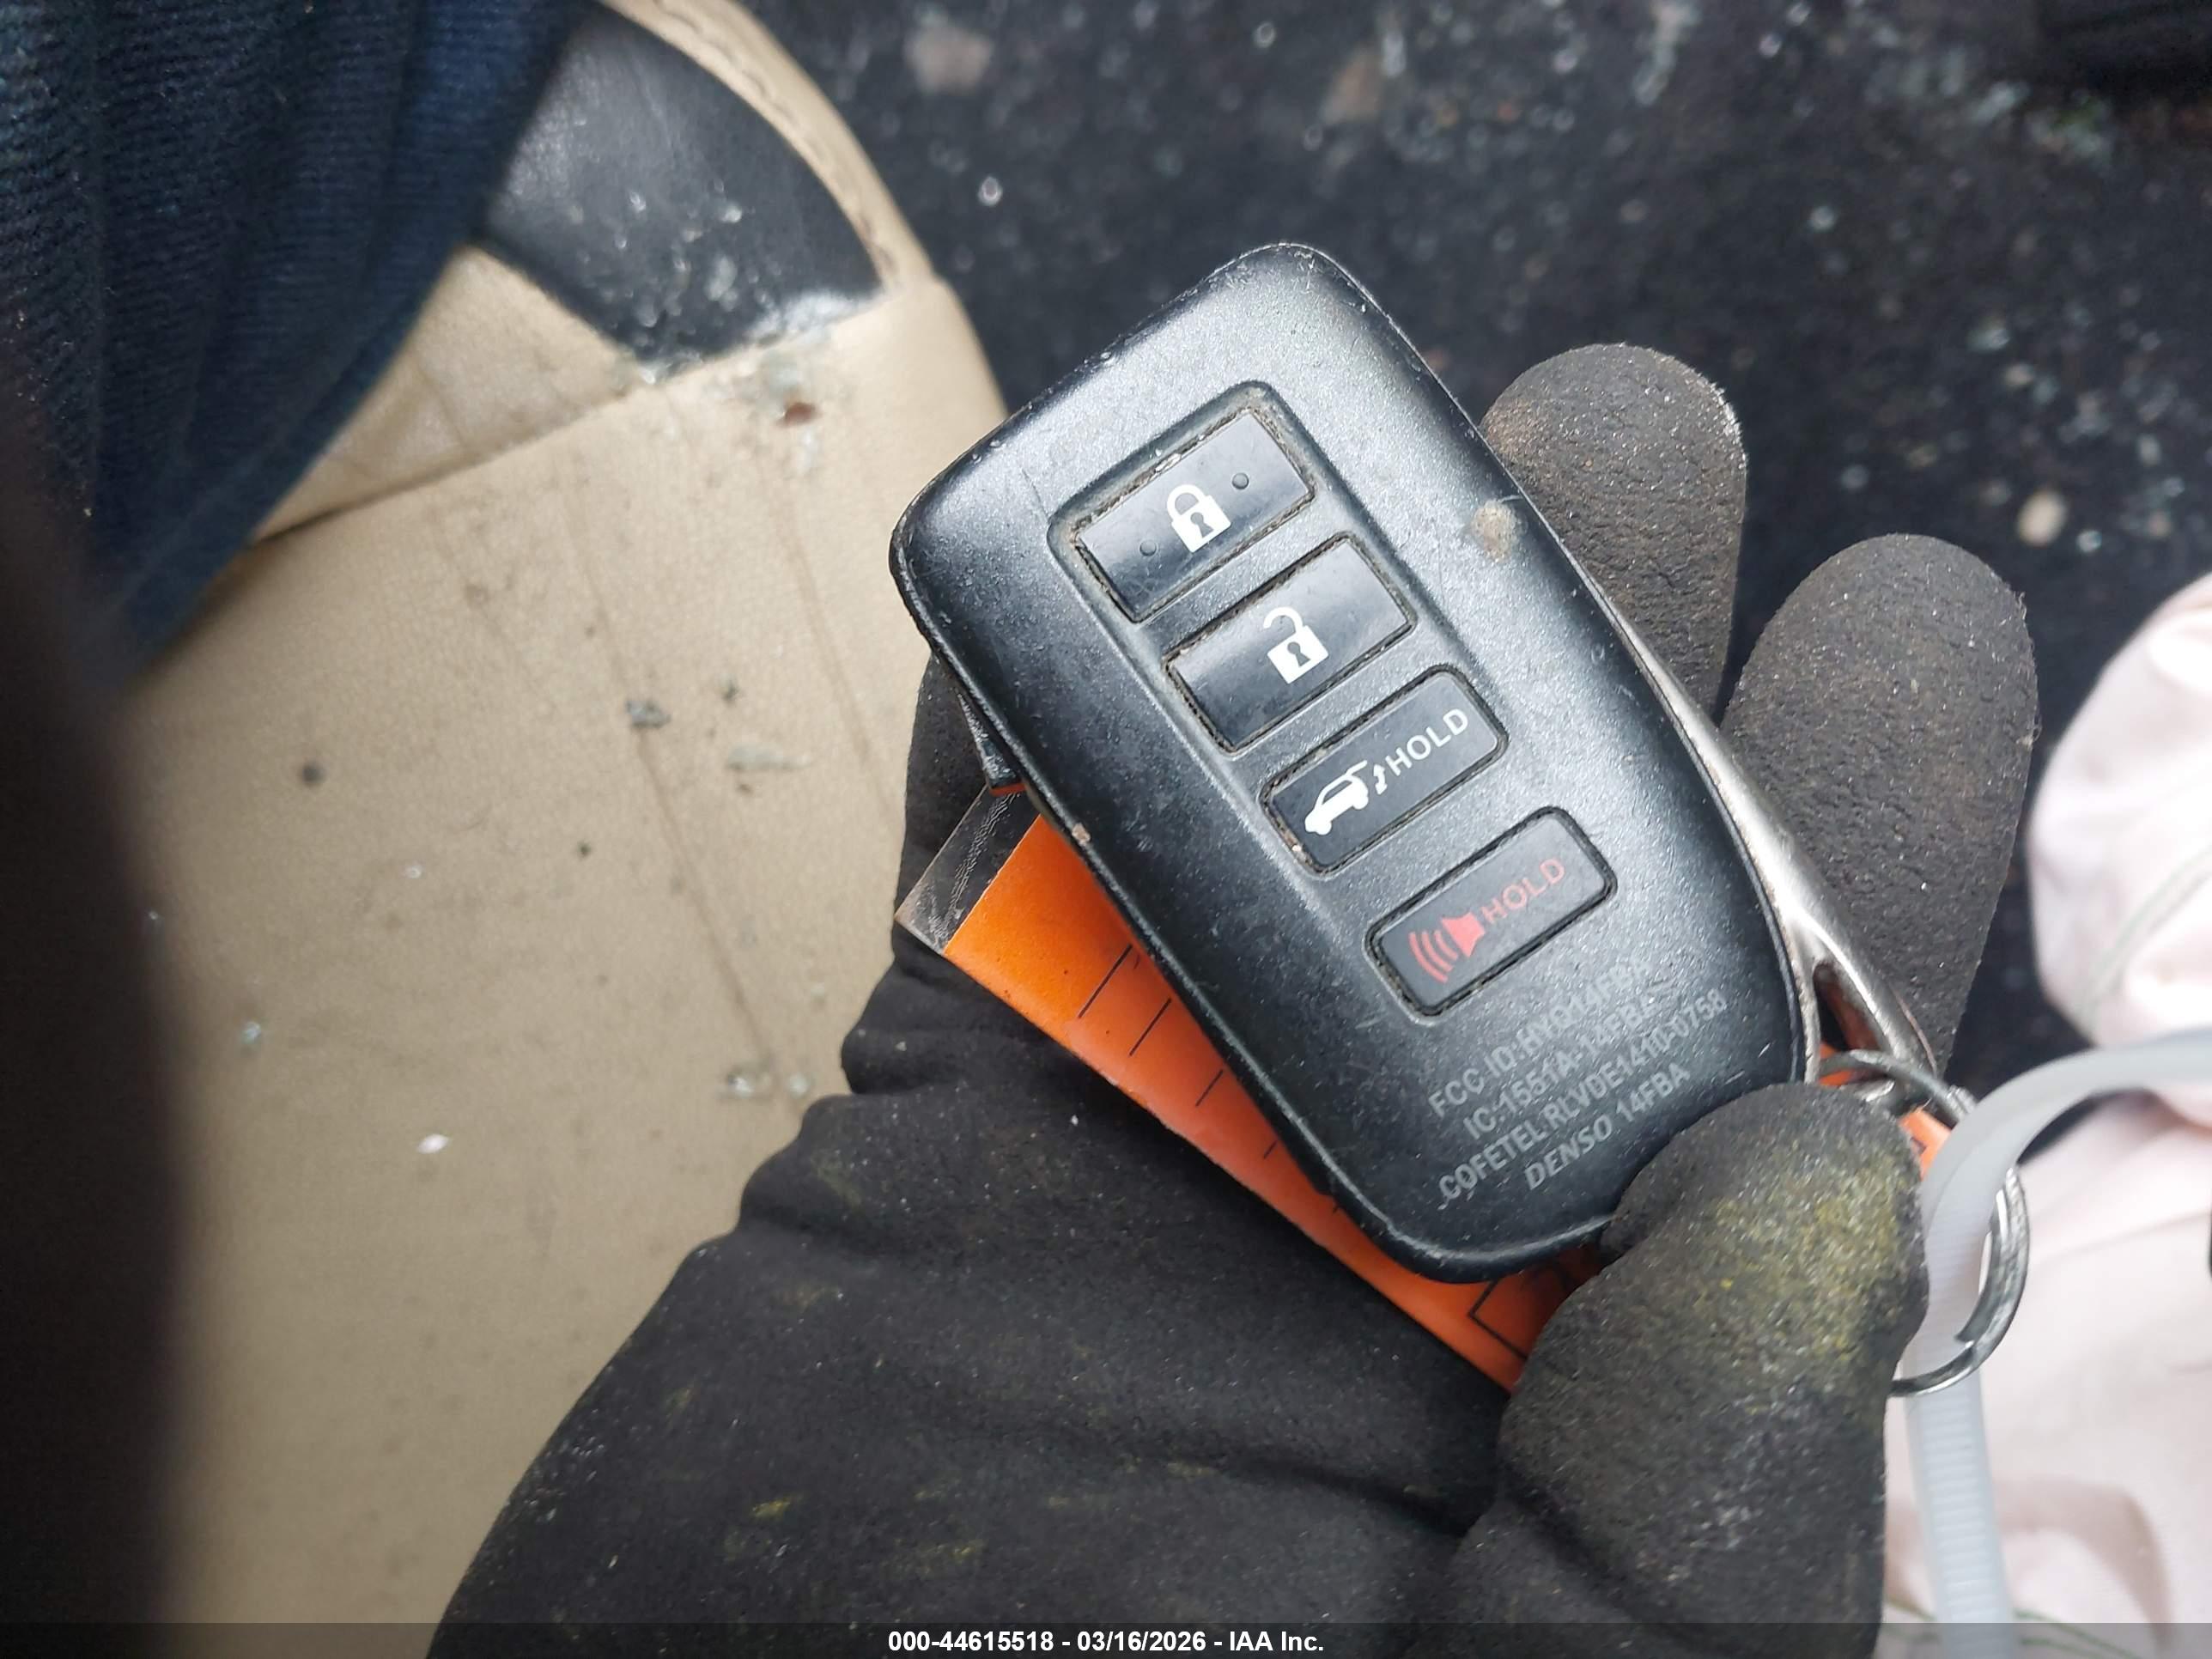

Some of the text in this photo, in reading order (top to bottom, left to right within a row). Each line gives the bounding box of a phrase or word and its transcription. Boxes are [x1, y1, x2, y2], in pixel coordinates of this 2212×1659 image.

[1386, 708, 1468, 776] HOLD
[1481, 859, 1565, 924] HOLD
[1428, 1068, 1486, 1117] FCC
[1524, 1062, 1691, 1190] DENSO 14FBA
[1439, 1119, 1544, 1200] COFETEL
